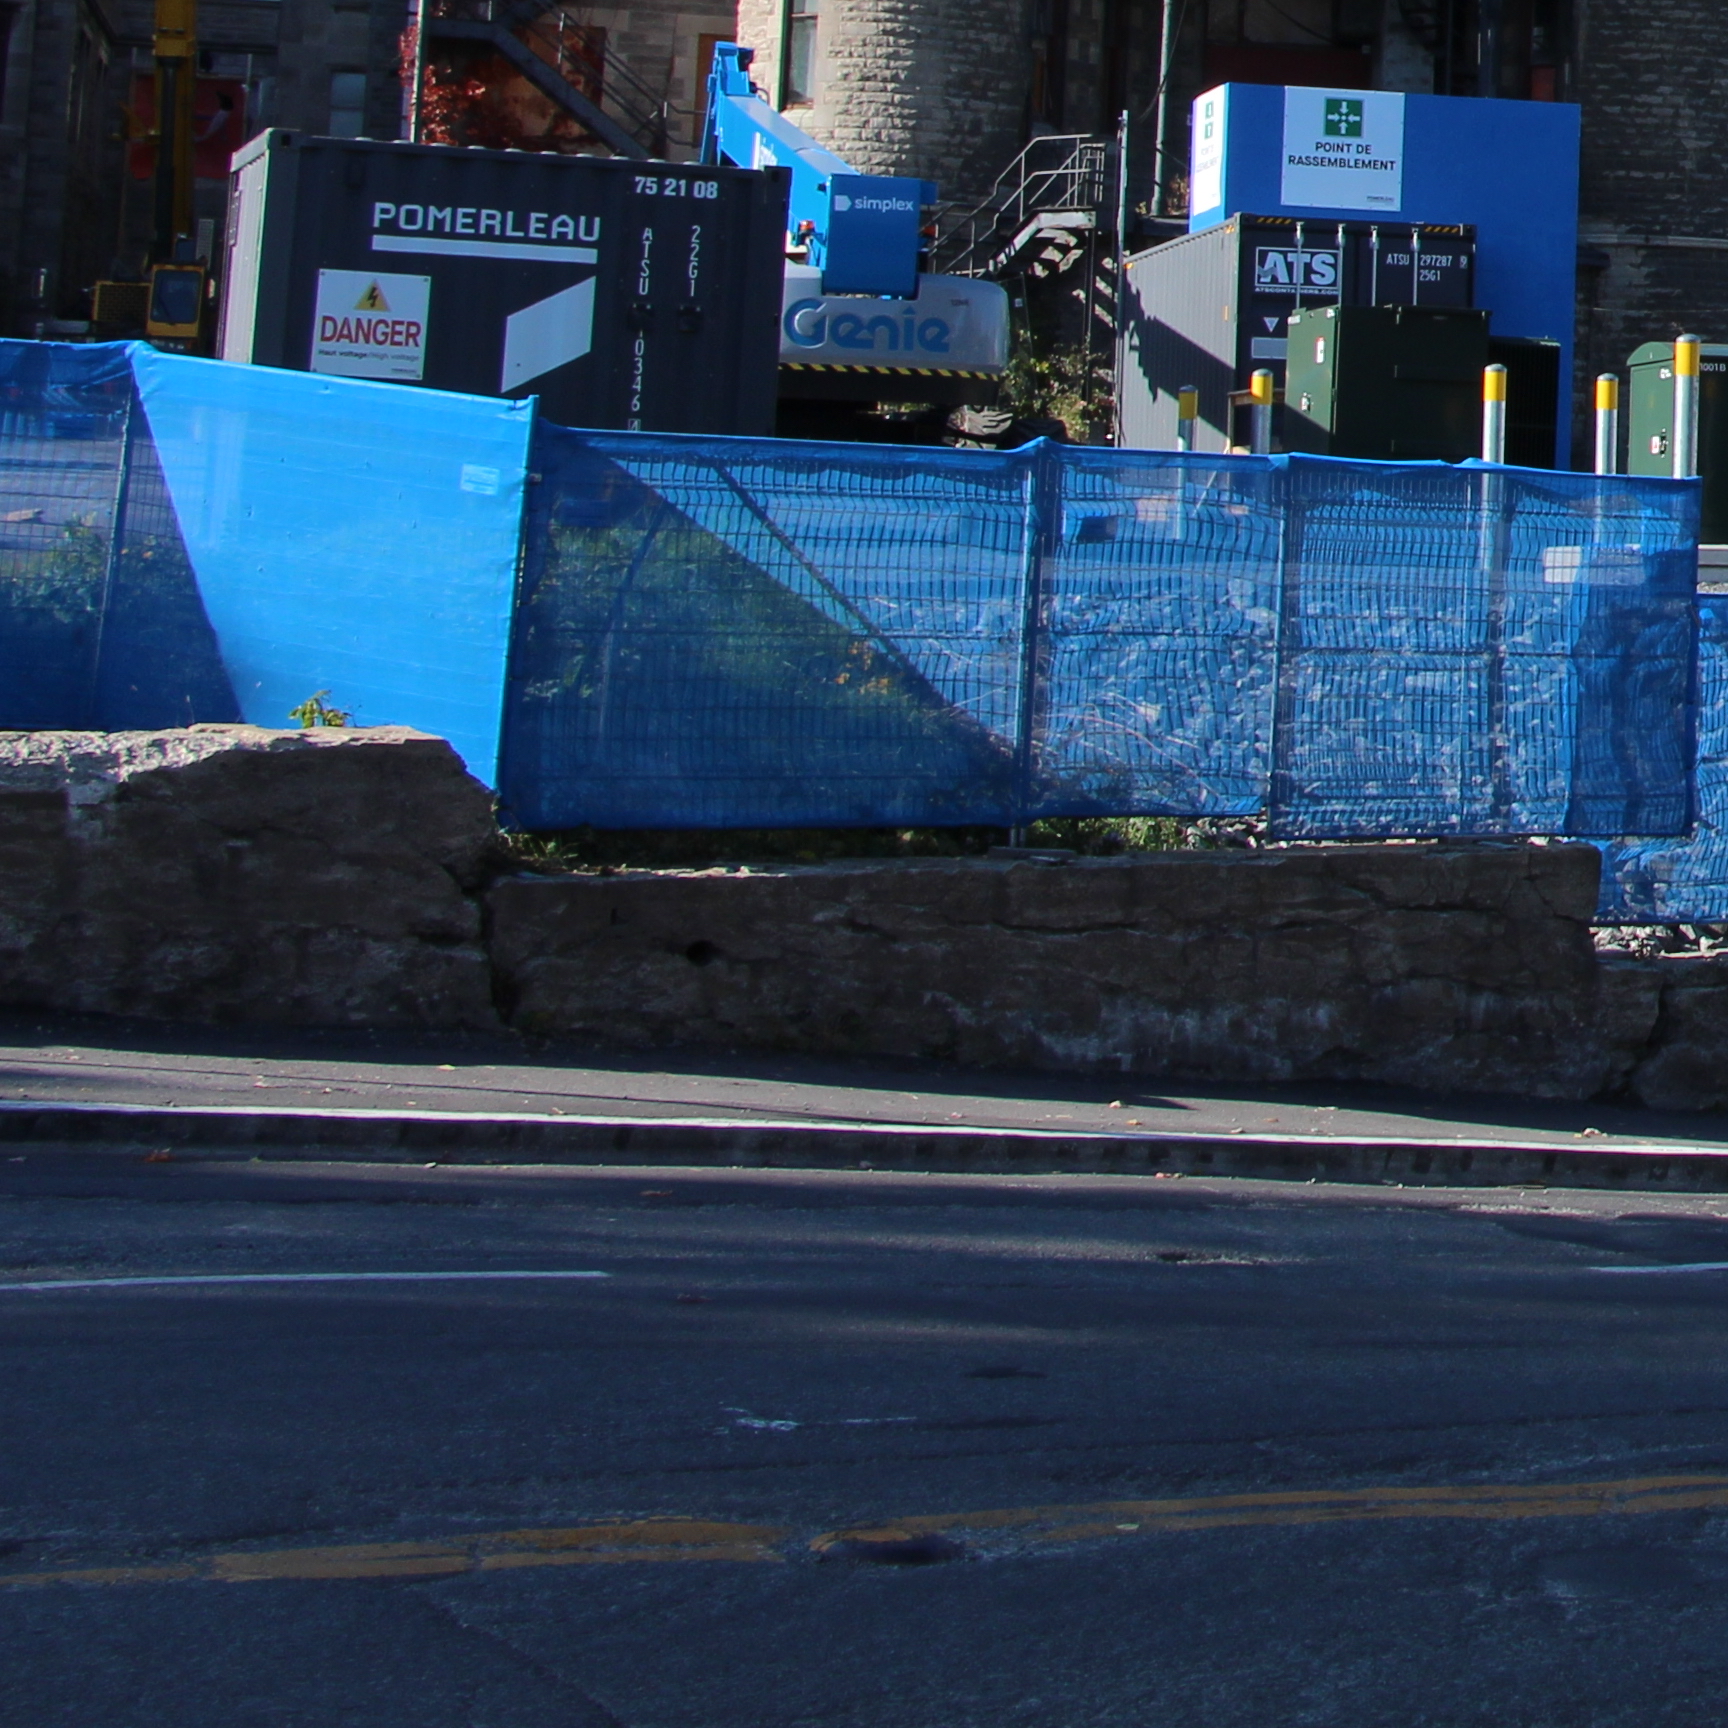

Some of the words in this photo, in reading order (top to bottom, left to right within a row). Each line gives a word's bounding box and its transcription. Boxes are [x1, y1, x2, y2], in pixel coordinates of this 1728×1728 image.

[1315, 141, 1352, 154] POINT
[1356, 144, 1372, 155] DE
[1288, 155, 1396, 171] RASSEMBLEMENT
[635, 176, 657, 195] 75
[664, 178, 686, 197] 21
[693, 180, 718, 199] 08
[855, 197, 914, 213] simplex
[372, 202, 600, 241] POMERLEAU
[638, 227, 653, 295] ATSU
[689, 225, 701, 297] 22G1
[1260, 252, 1336, 285] ATS
[1386, 253, 1410, 265] ATSU
[1419, 255, 1453, 267] 297287
[1419, 269, 1441, 281] 25G1
[320, 315, 421, 347] DANGER
[783, 297, 950, 353] Genie
